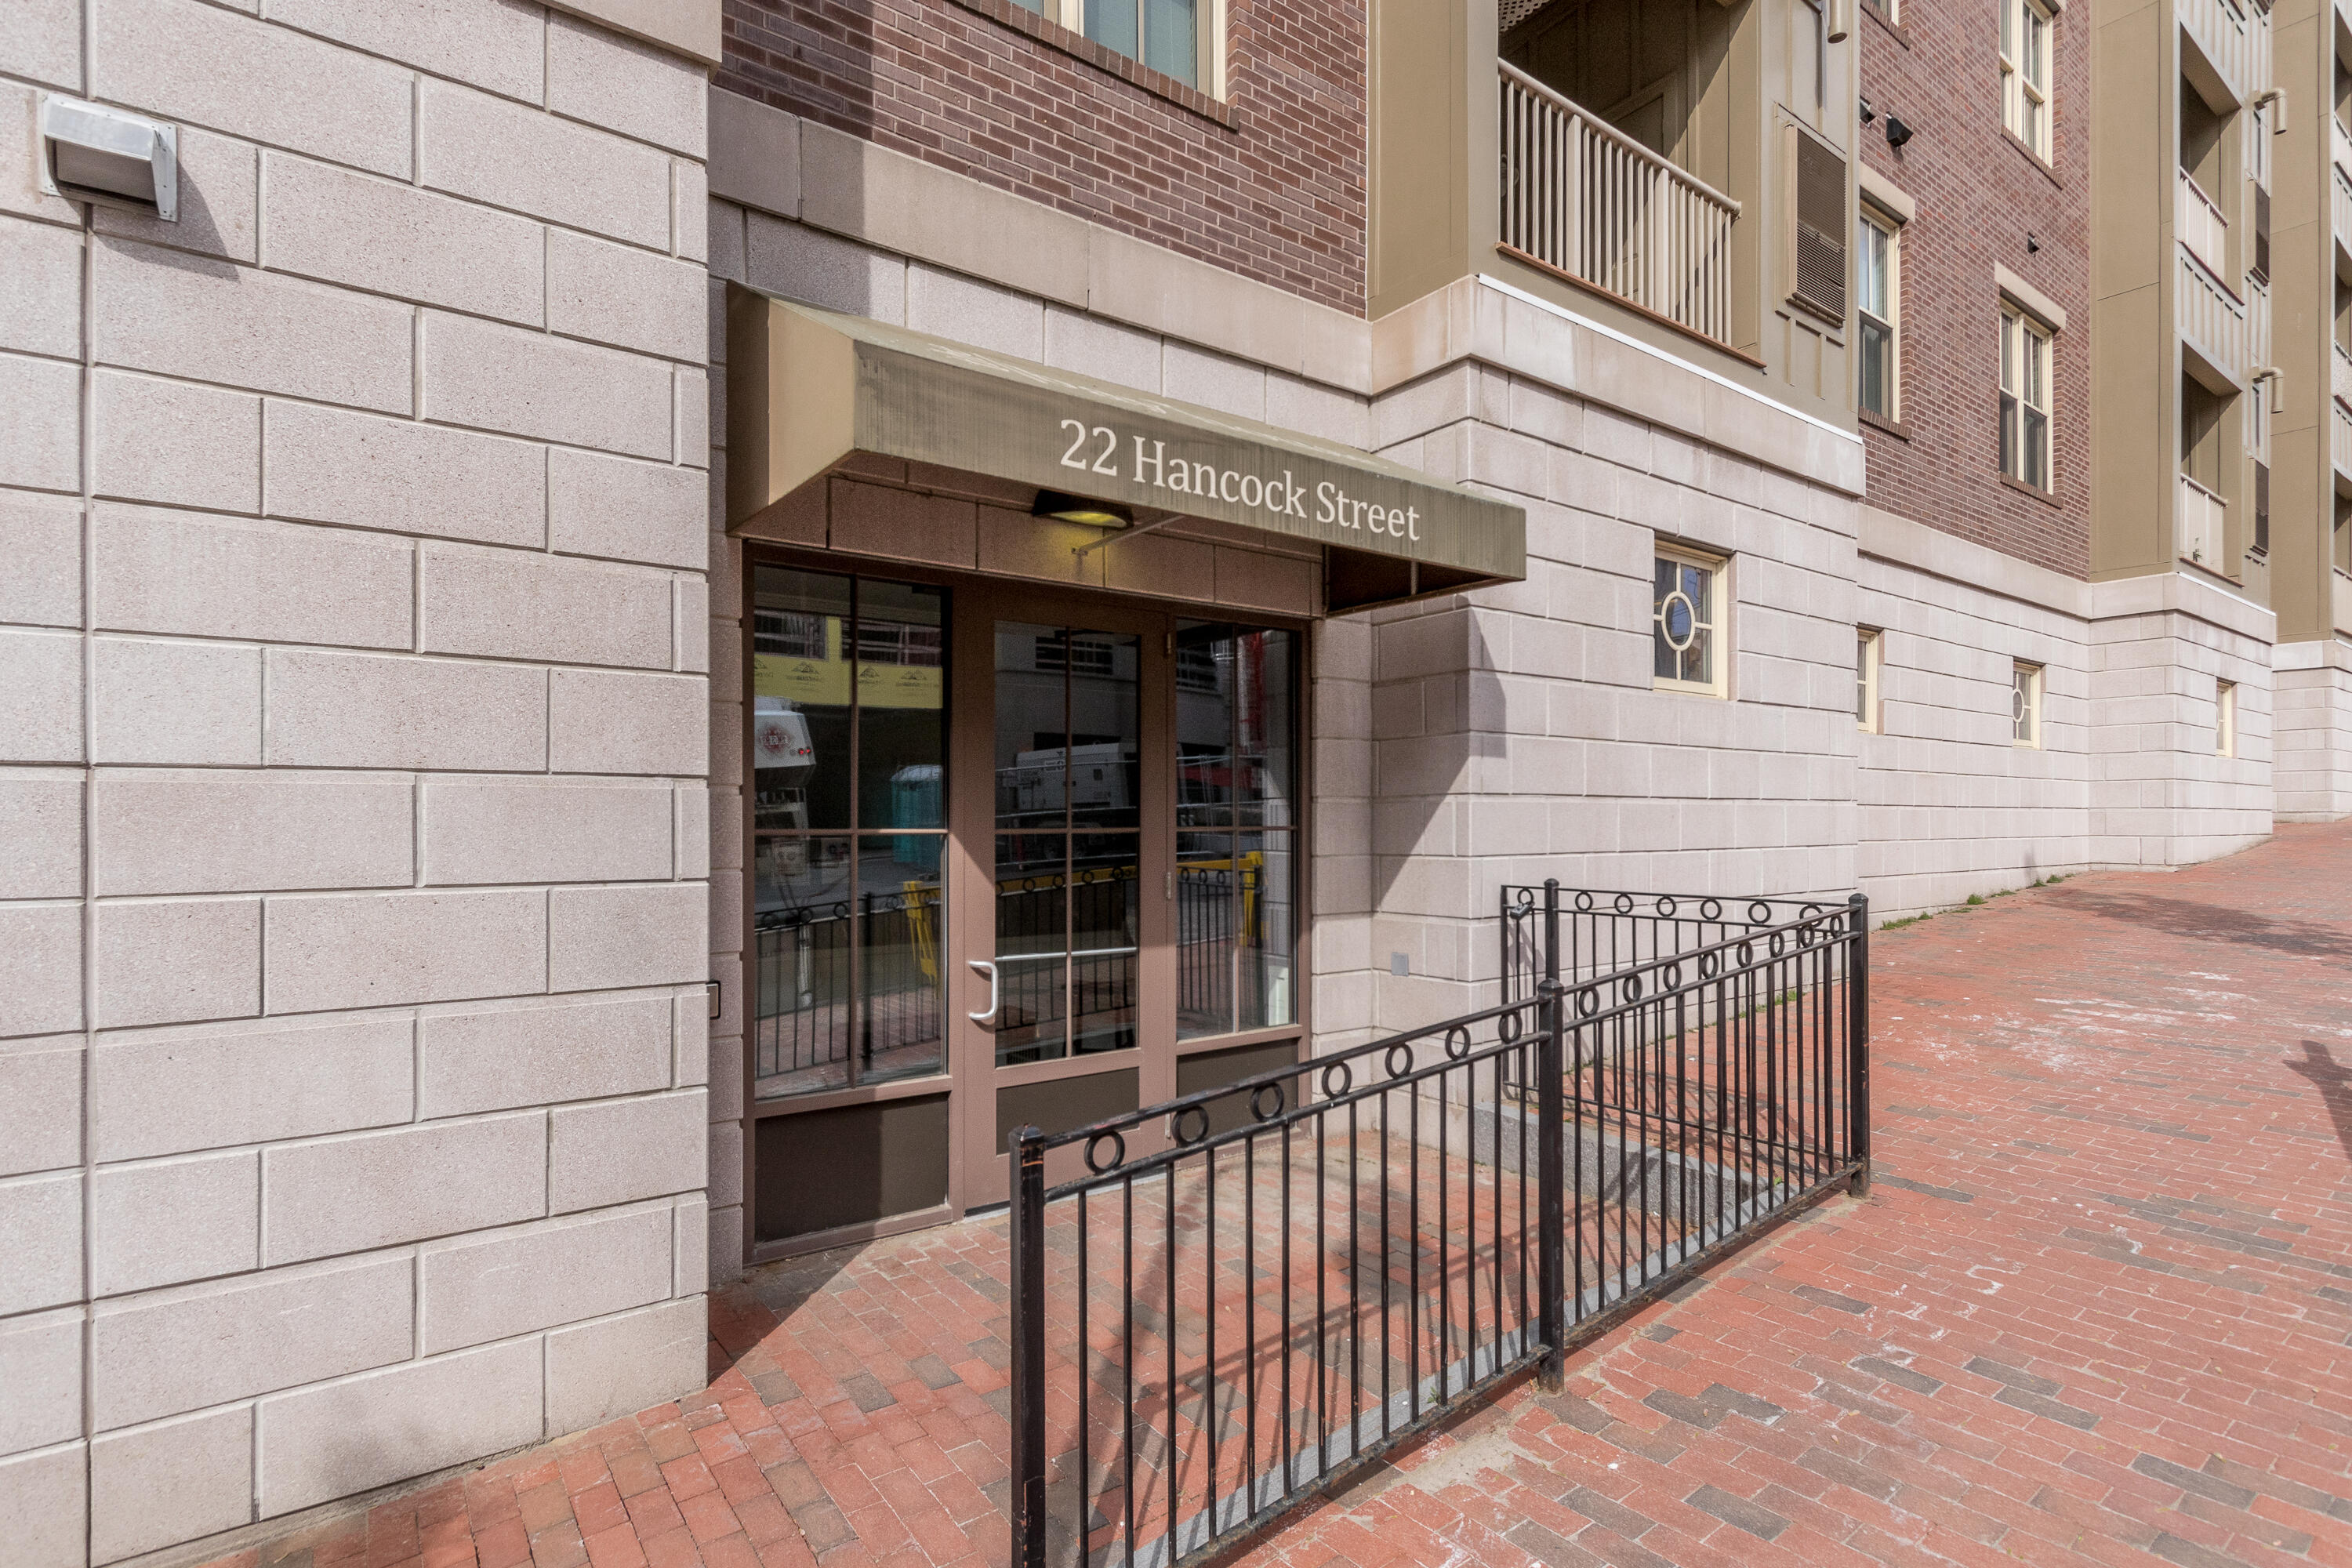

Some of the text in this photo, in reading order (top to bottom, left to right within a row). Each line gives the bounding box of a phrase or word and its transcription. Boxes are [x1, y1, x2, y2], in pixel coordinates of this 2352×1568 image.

[1060, 419, 1421, 542] 22 Hancock Street
